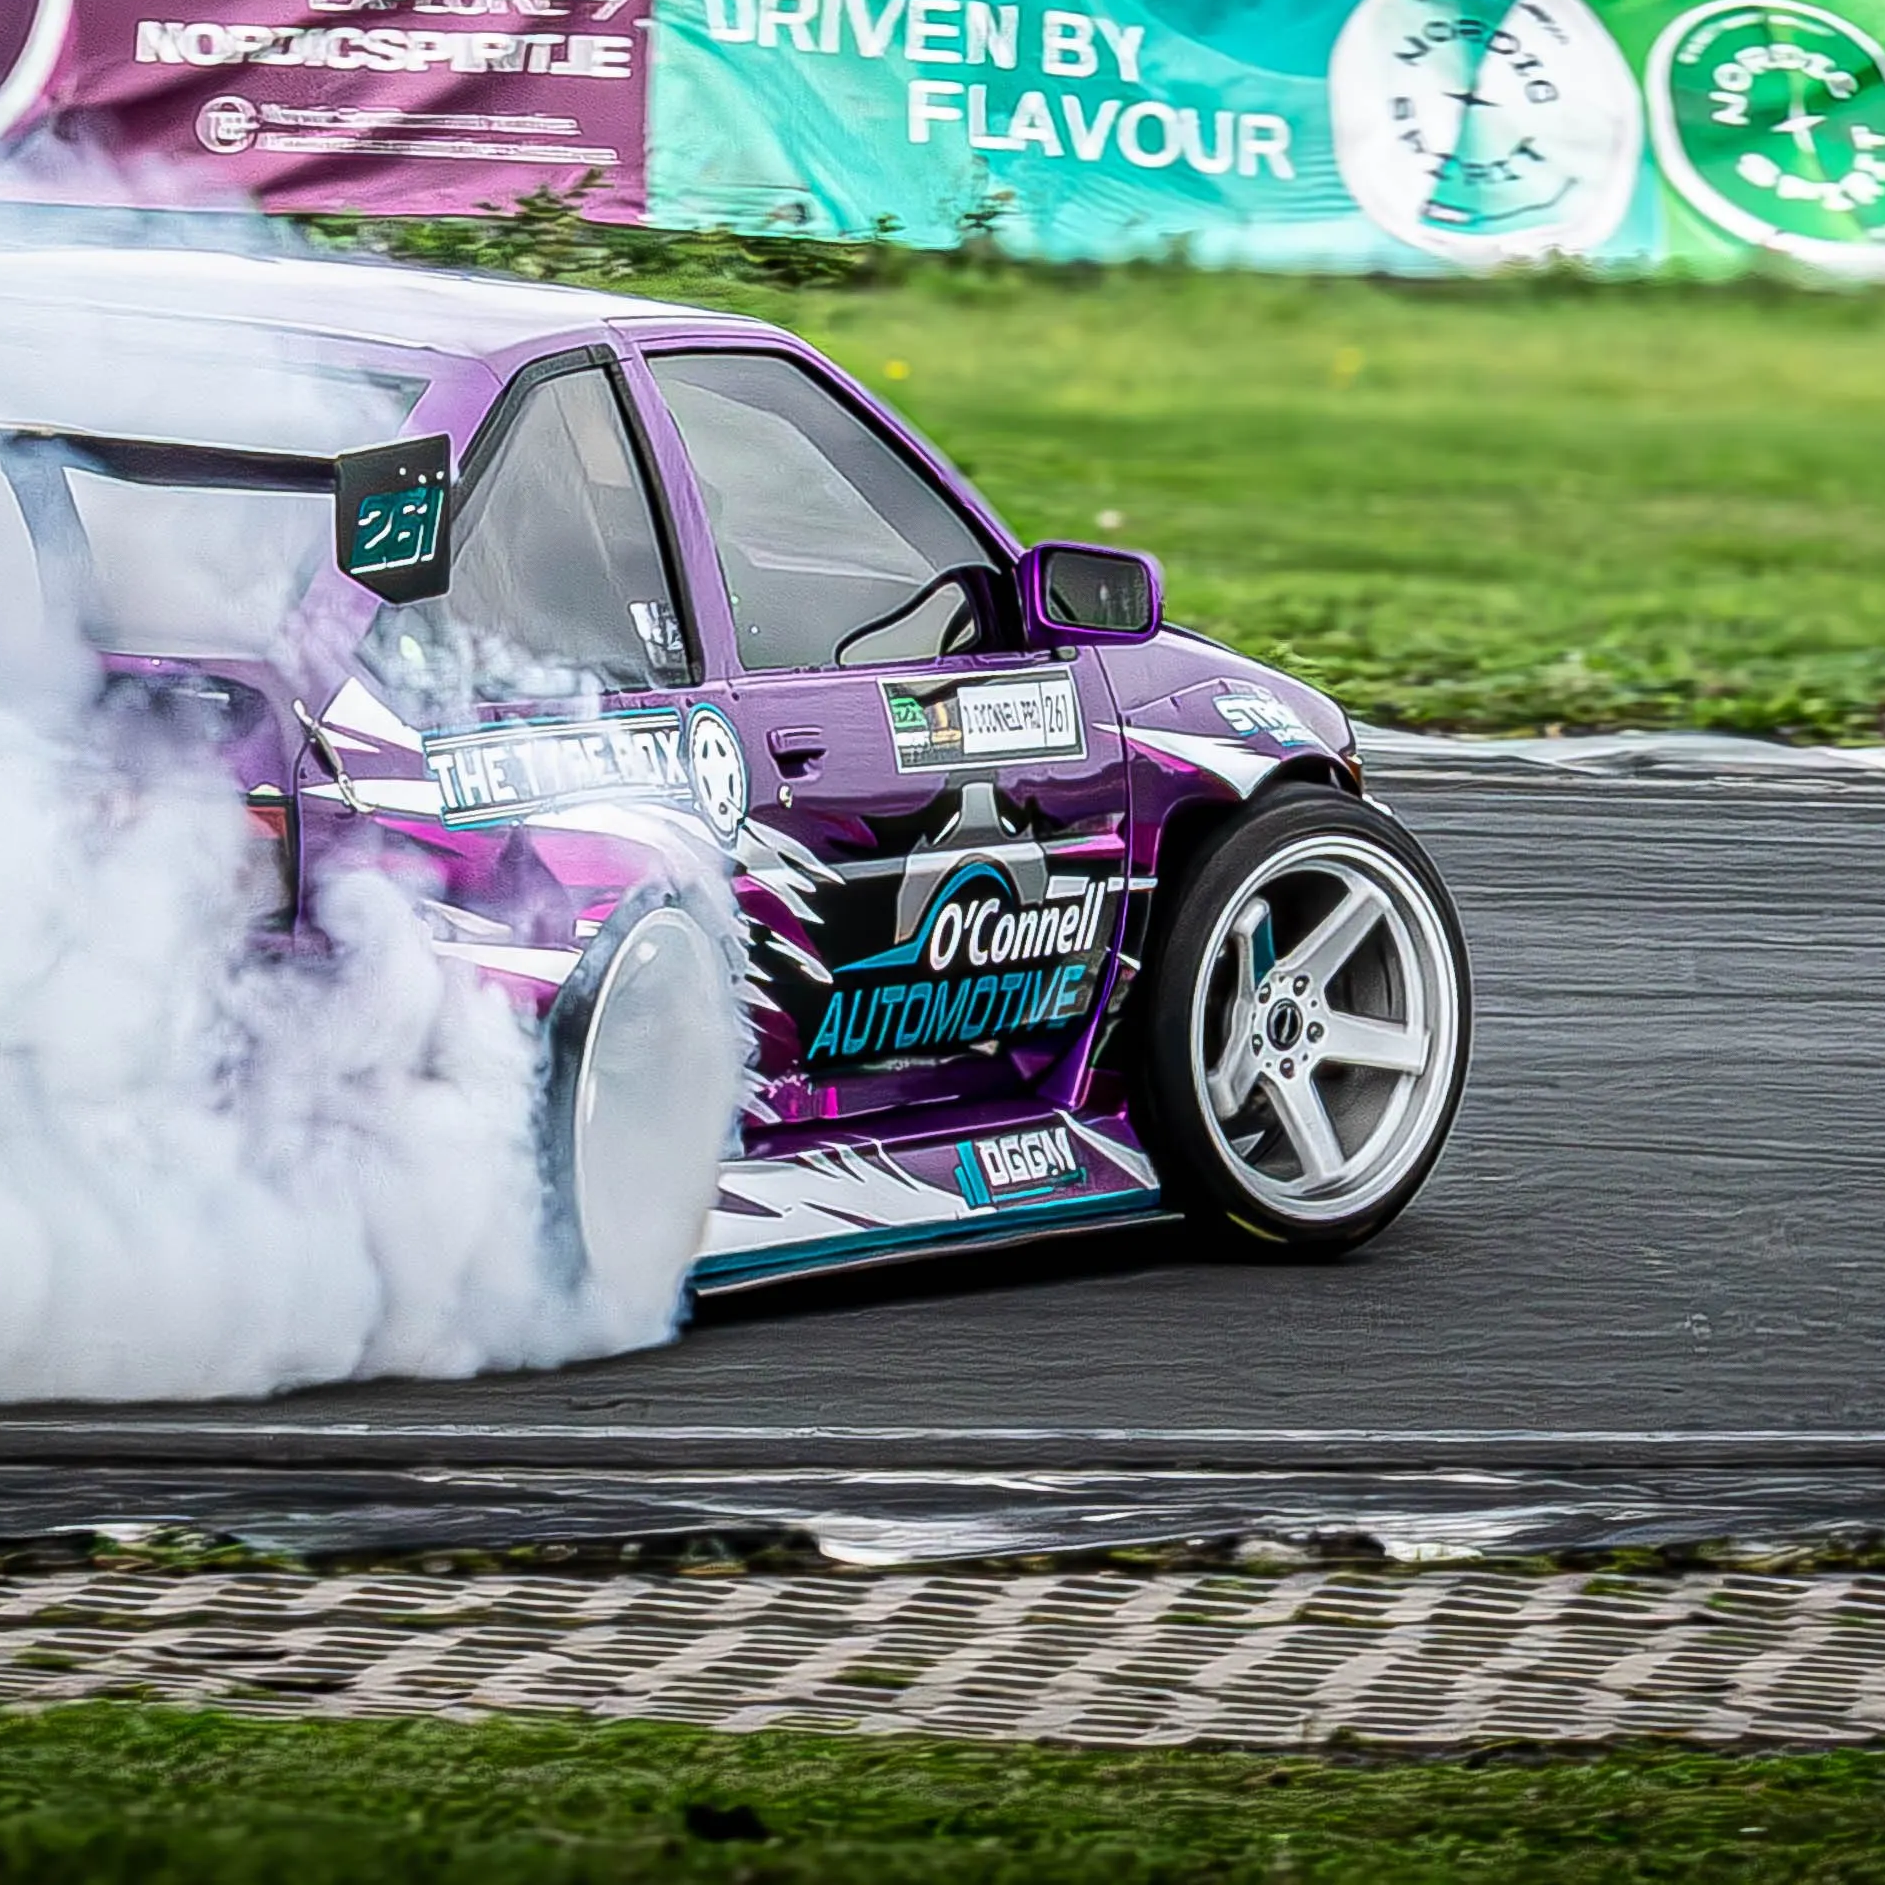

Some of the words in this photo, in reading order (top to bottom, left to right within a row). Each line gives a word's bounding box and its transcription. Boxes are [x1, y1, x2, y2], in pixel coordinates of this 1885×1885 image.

[1041, 10, 1145, 83] BY
[1708, 43, 1860, 126] NORDIC
[907, 80, 1295, 179] FLAVOUR
[1045, 694, 1069, 733] 261
[427, 746, 518, 809] THE
[930, 882, 1106, 971] O'Connell
[807, 964, 1087, 1061] AUTOMOTIVE
